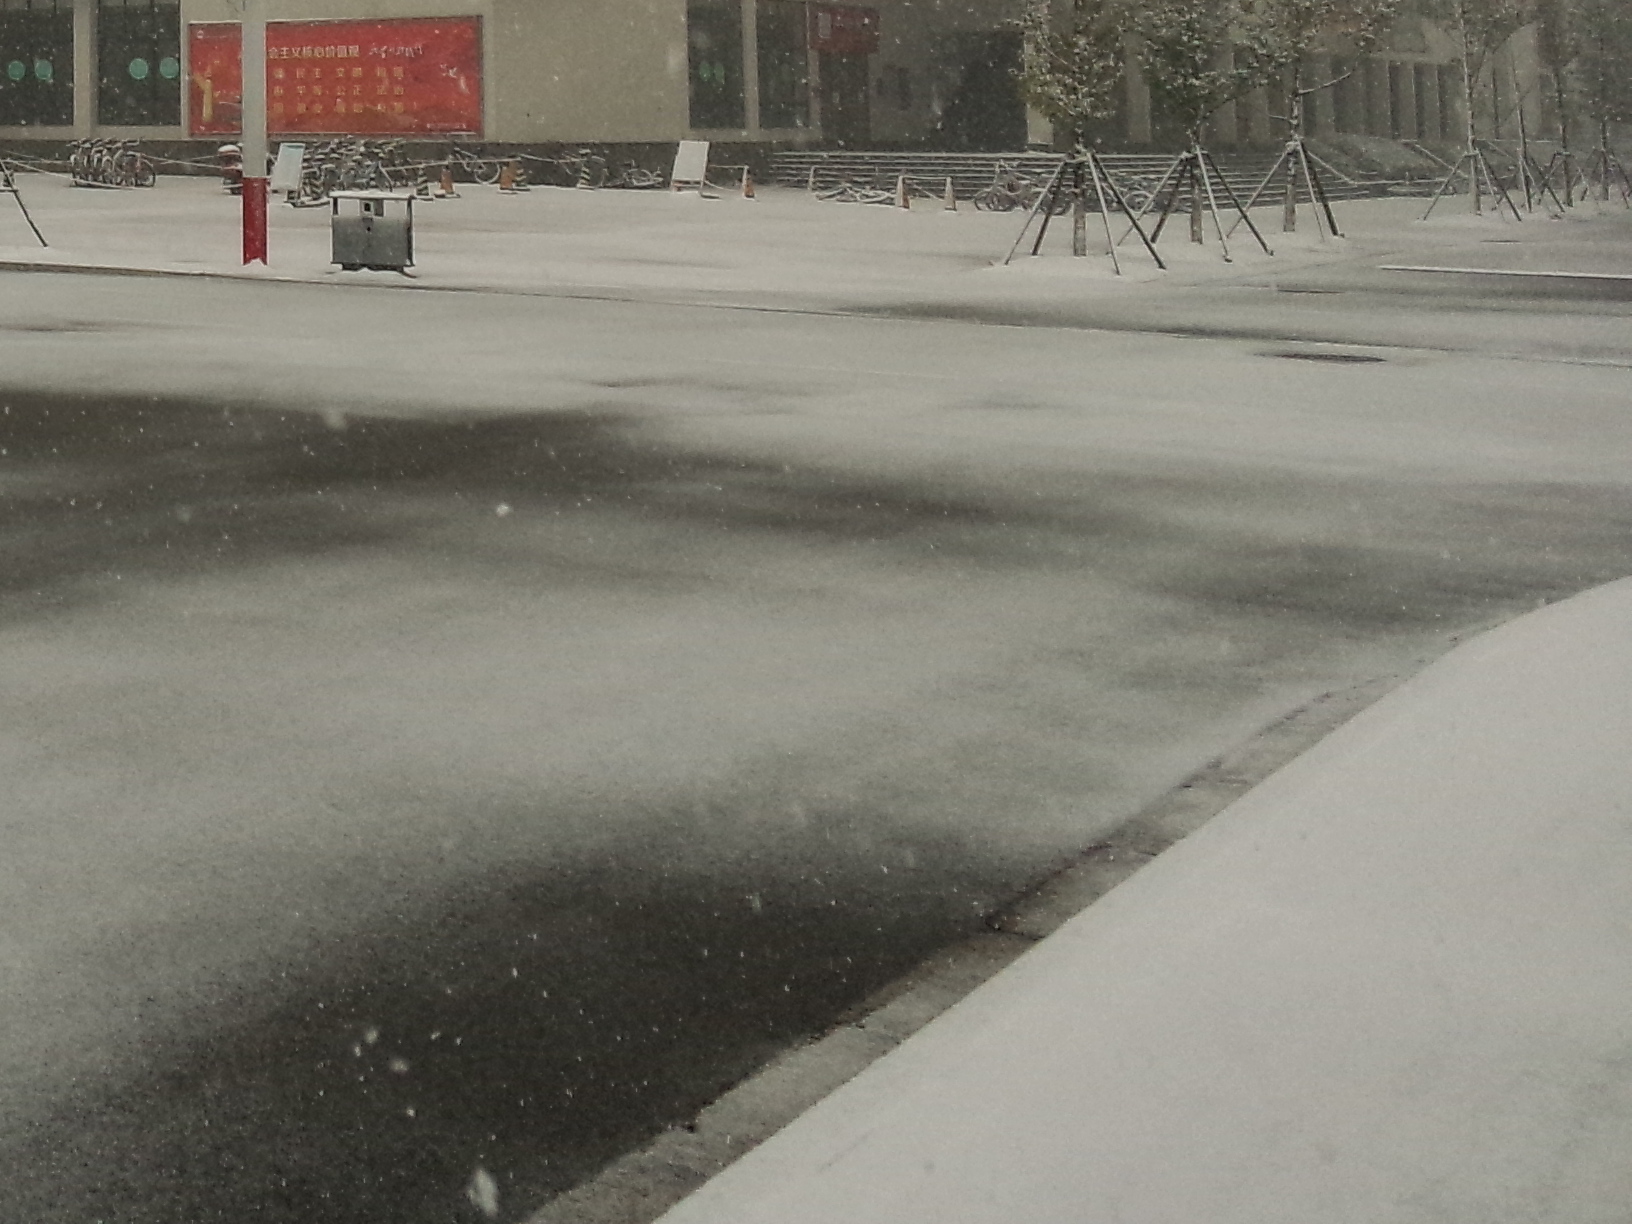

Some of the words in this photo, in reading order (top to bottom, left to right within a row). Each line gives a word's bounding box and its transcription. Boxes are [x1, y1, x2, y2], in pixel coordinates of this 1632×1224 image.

[268, 44, 360, 60] 会主义核心价值观
